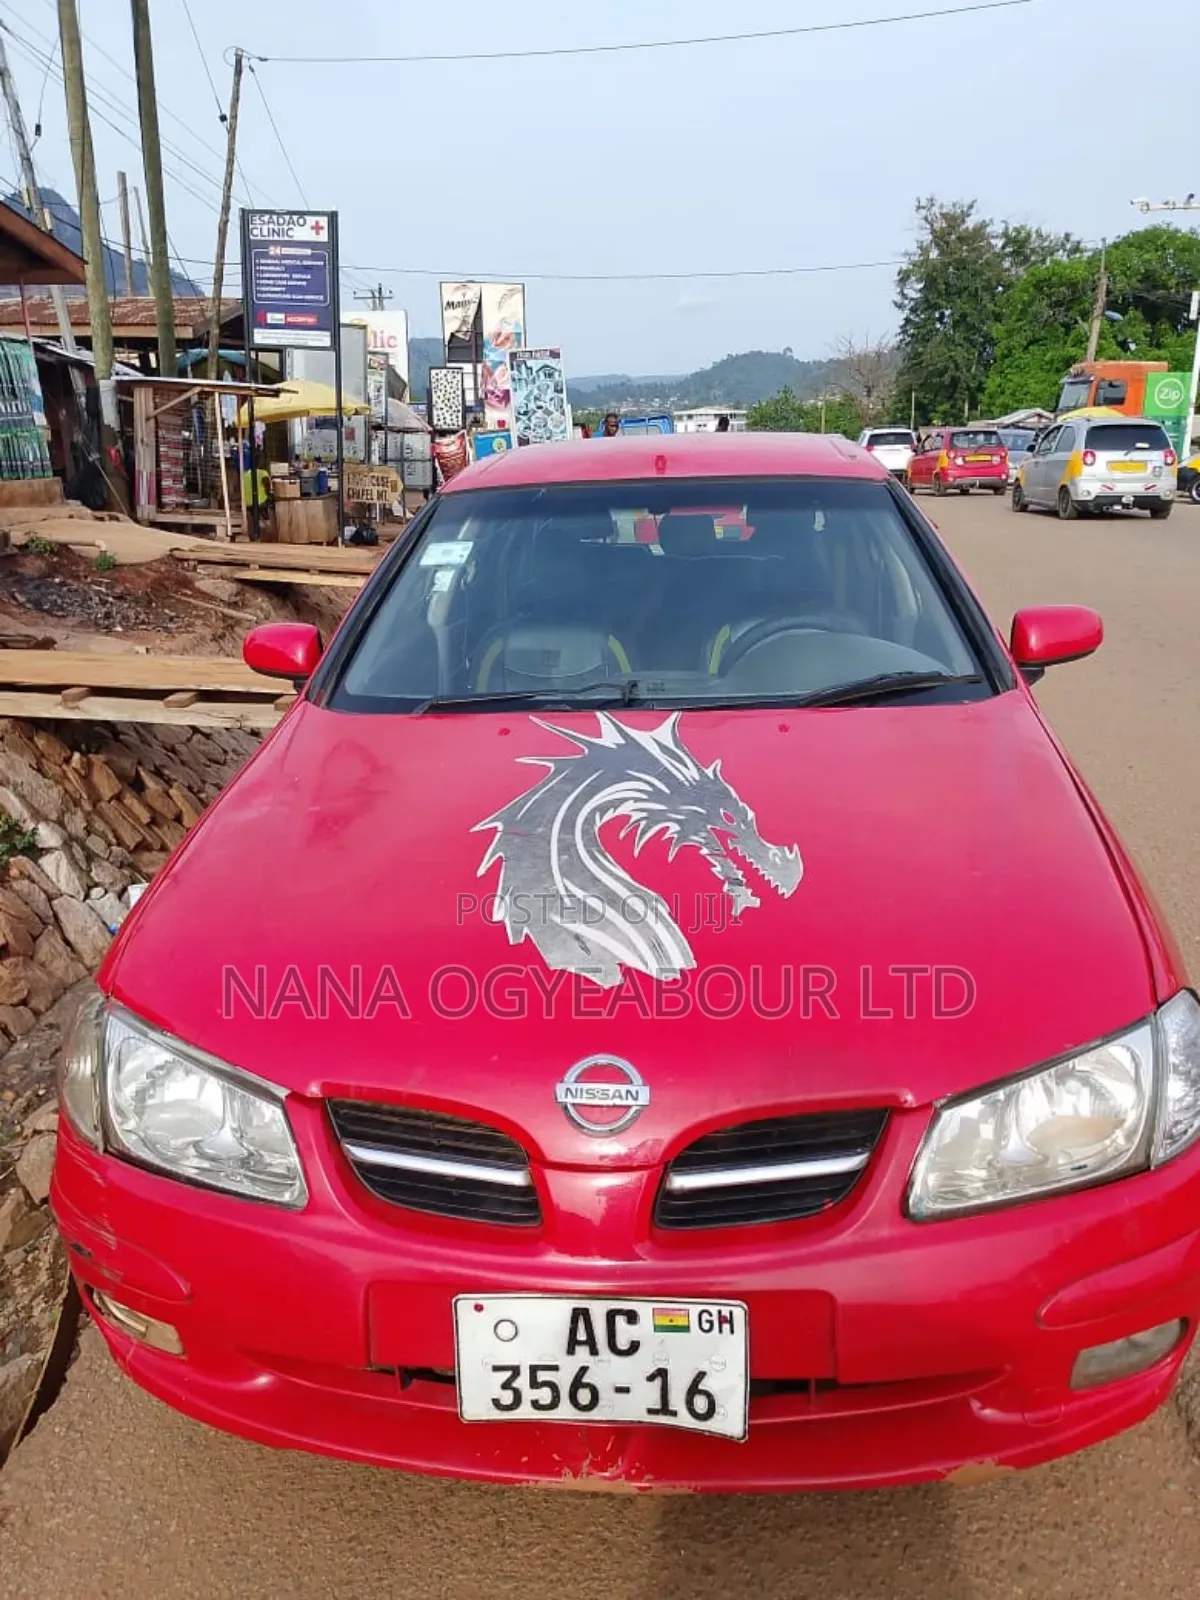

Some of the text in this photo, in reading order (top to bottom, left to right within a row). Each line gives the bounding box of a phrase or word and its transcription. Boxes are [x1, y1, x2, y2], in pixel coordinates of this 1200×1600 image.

[250, 214, 307, 227] ESADAO
[250, 226, 295, 238] CLINIC
[367, 329, 398, 349] lic
[1159, 388, 1181, 401] Zip
[564, 1086, 640, 1102] NISSAN
[565, 1306, 735, 1358] AC GH
[490, 1363, 717, 1422] 356-16
